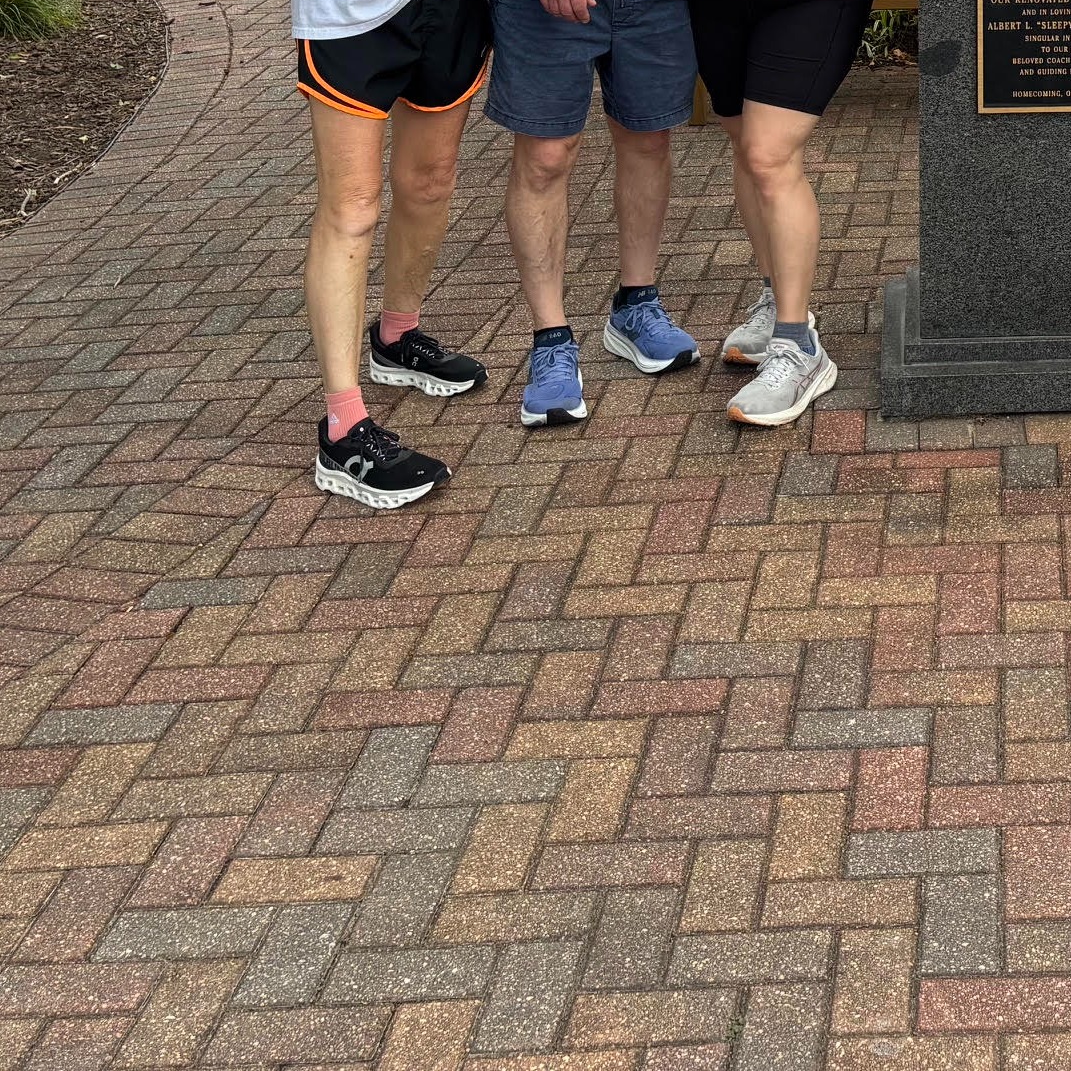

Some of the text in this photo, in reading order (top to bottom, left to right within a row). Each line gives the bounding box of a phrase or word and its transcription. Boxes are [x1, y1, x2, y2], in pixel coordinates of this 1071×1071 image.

[1021, 8, 1037, 16] AND
[1039, 8, 1048, 16] IN
[987, 21, 1022, 31] ALBERT
[1024, 34, 1060, 42] SINGULAR
[1062, 34, 1071, 42] IN
[1040, 45, 1051, 53] TO
[1053, 45, 1069, 53] OUR
[1012, 57, 1044, 65] BELOVED
[1046, 56, 1071, 64] COACH
[1019, 68, 1035, 76] AND
[1036, 68, 1068, 76] GUIDING
